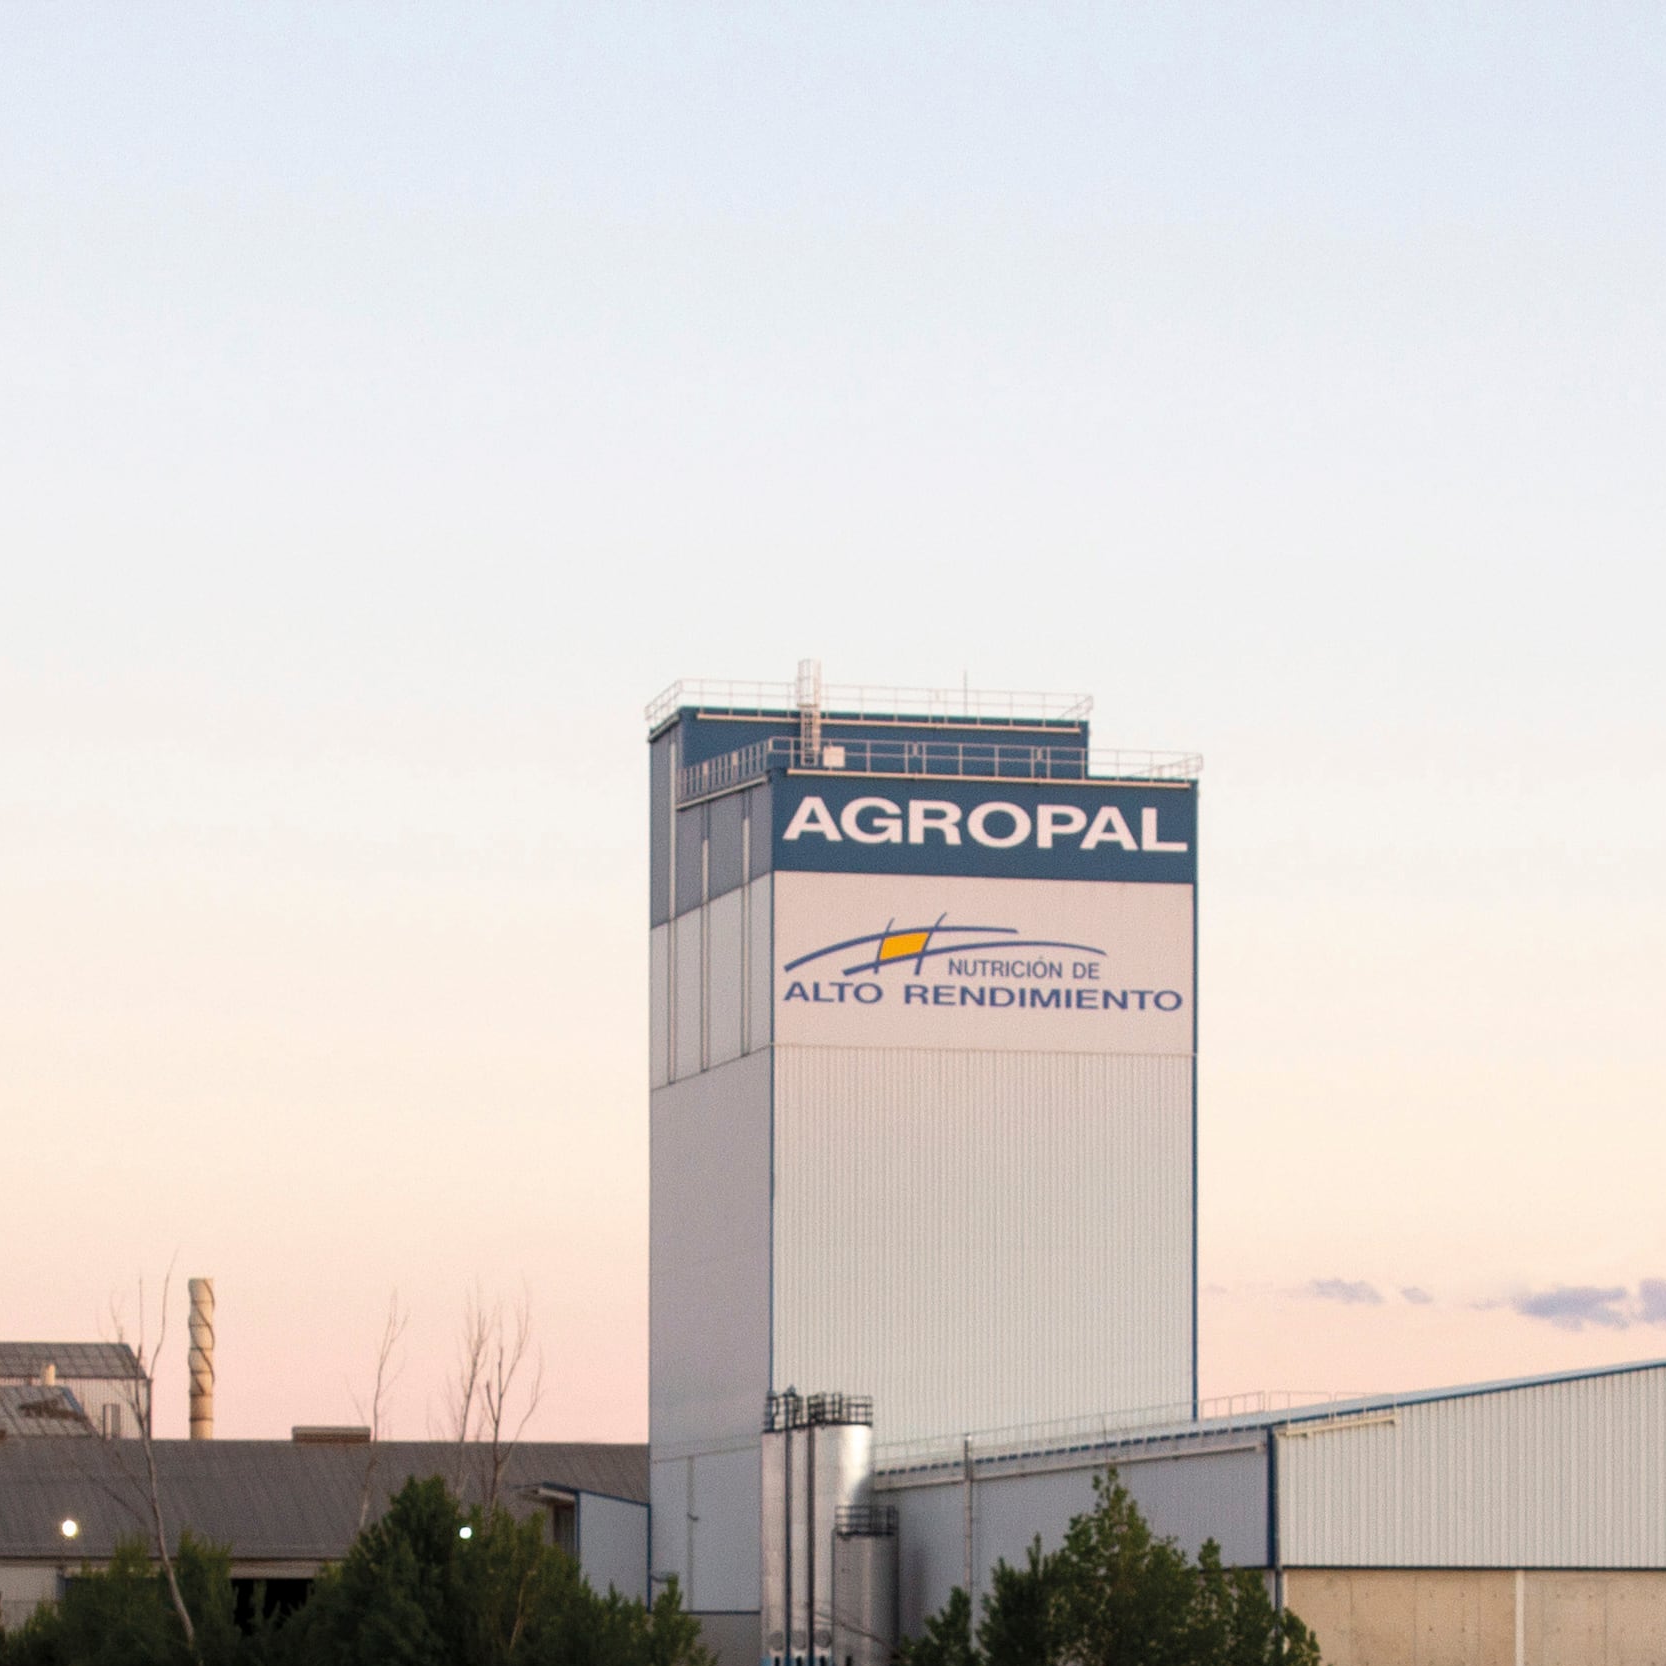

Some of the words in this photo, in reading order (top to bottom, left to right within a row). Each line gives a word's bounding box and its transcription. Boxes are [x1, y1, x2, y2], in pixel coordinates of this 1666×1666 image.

[782, 795, 1189, 852] AGROPAL
[948, 955, 1063, 979] NUTRICIÓN
[1072, 962, 1100, 980] DE
[783, 981, 883, 1004] ALTO
[903, 985, 1183, 1012] RENDIMIENTO
